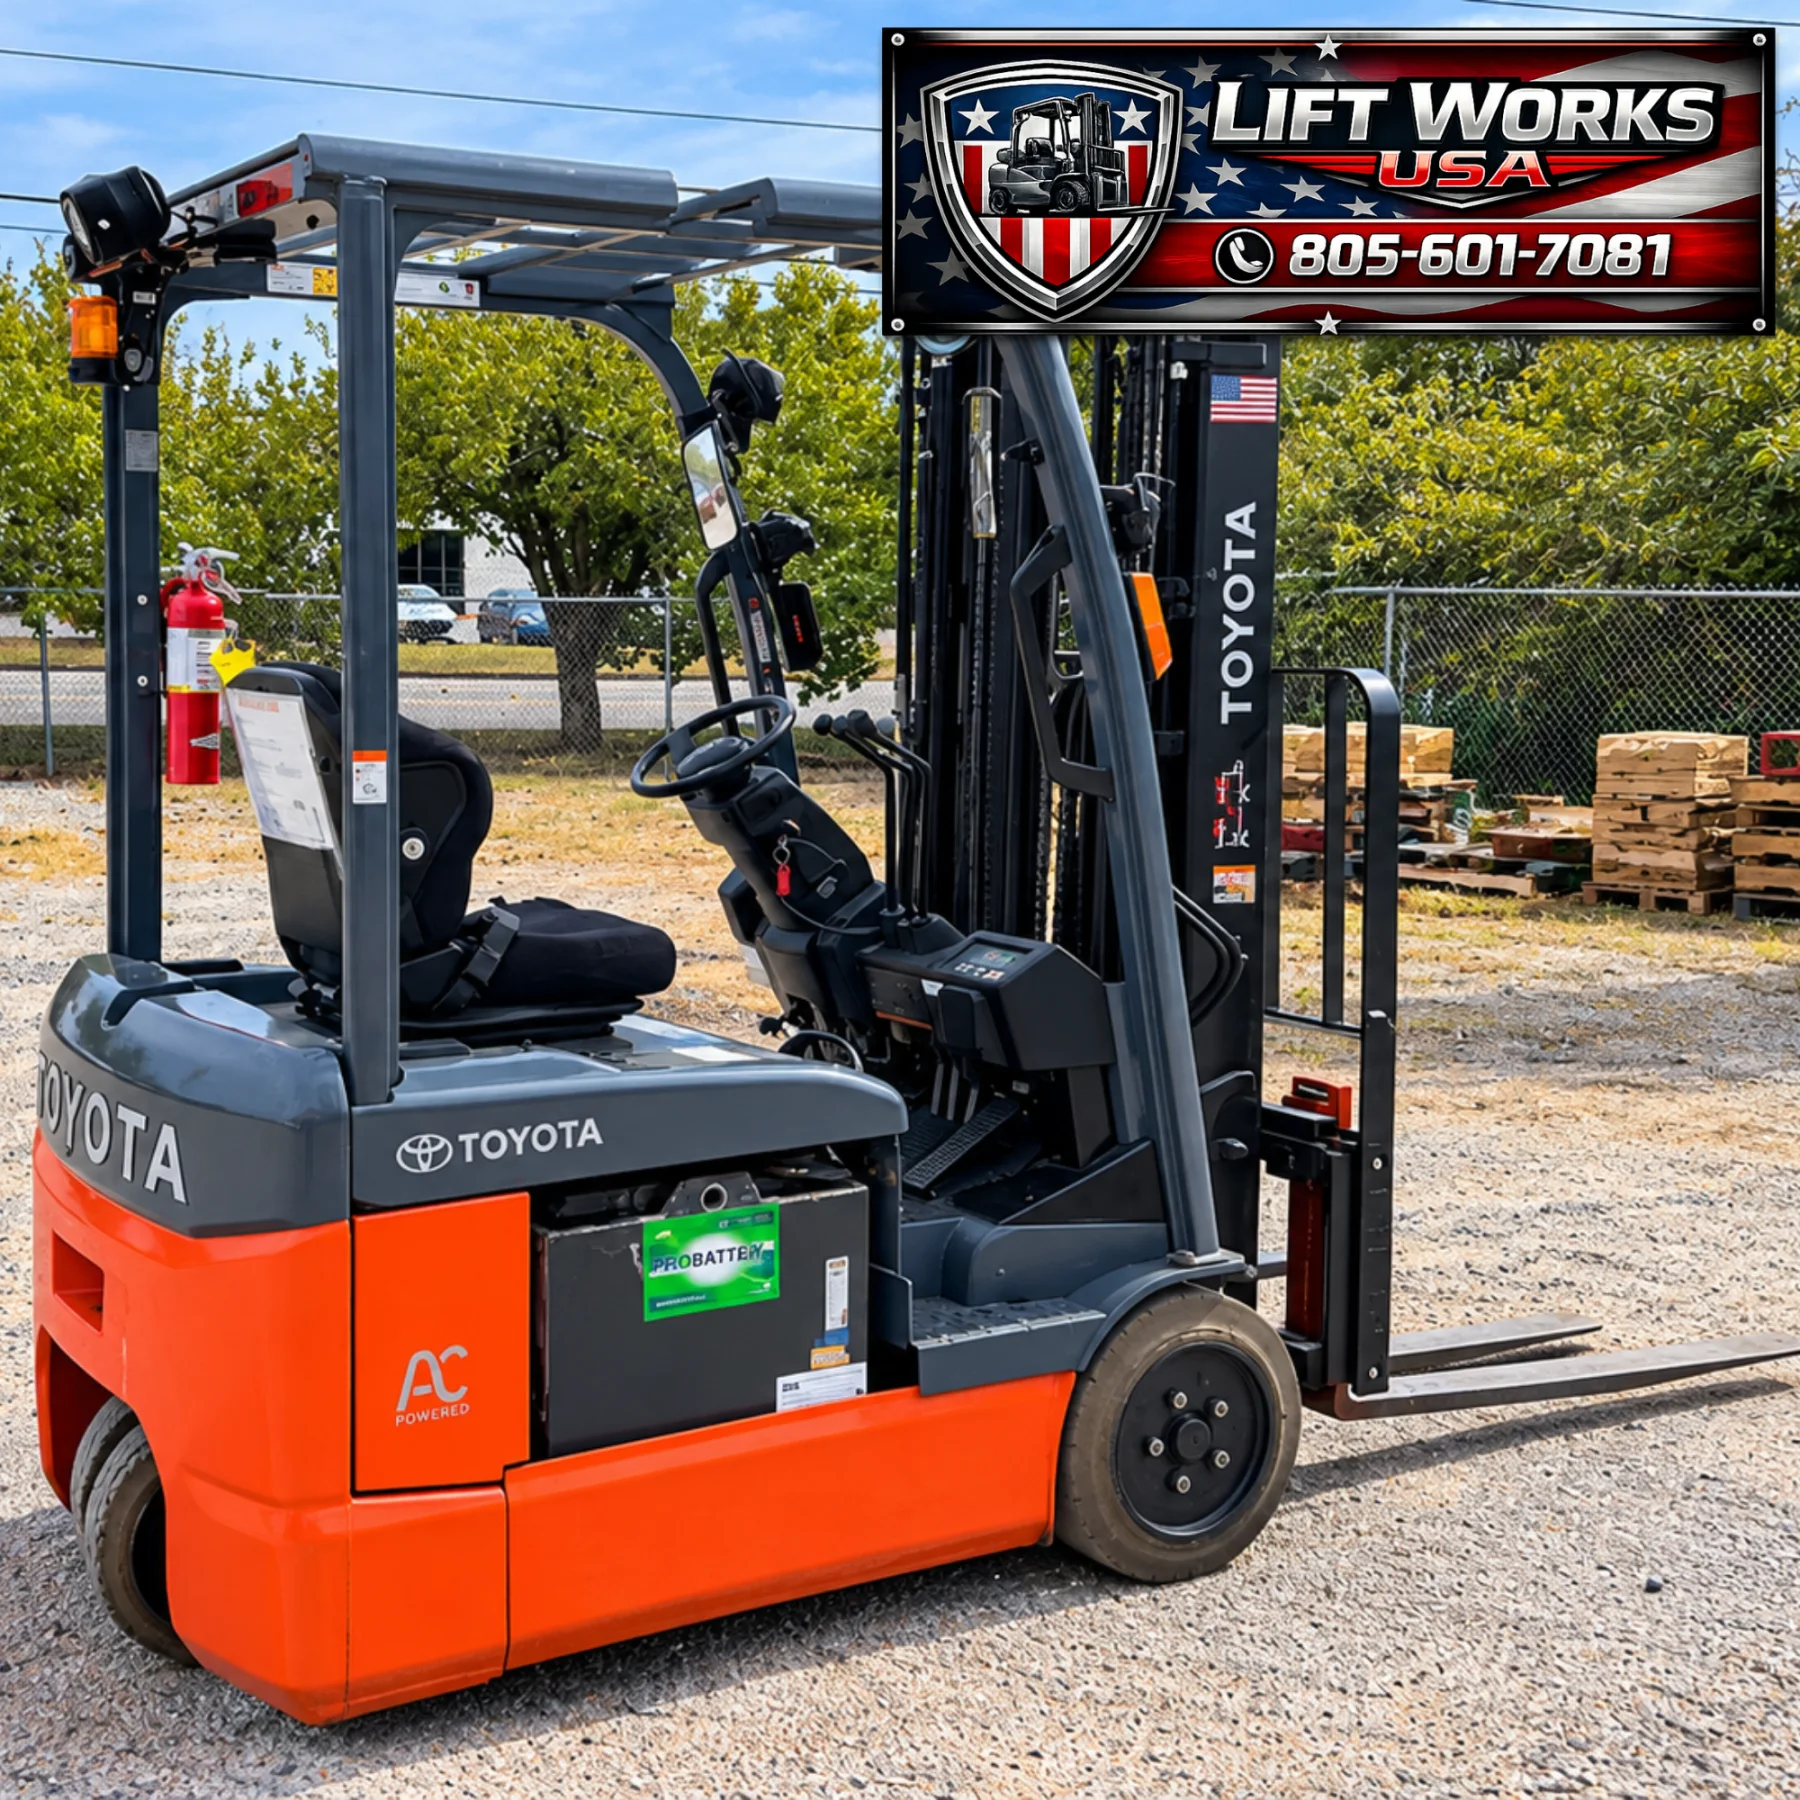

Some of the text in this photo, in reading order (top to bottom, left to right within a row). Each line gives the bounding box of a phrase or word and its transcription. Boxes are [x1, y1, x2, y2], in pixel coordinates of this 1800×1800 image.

[1220, 501, 1257, 725] TOYOTA
[37, 1050, 189, 1206] TOYOTA
[458, 1118, 604, 1162] TOYOTA
[396, 1344, 468, 1412] AC
[396, 1403, 470, 1427] POWERED
